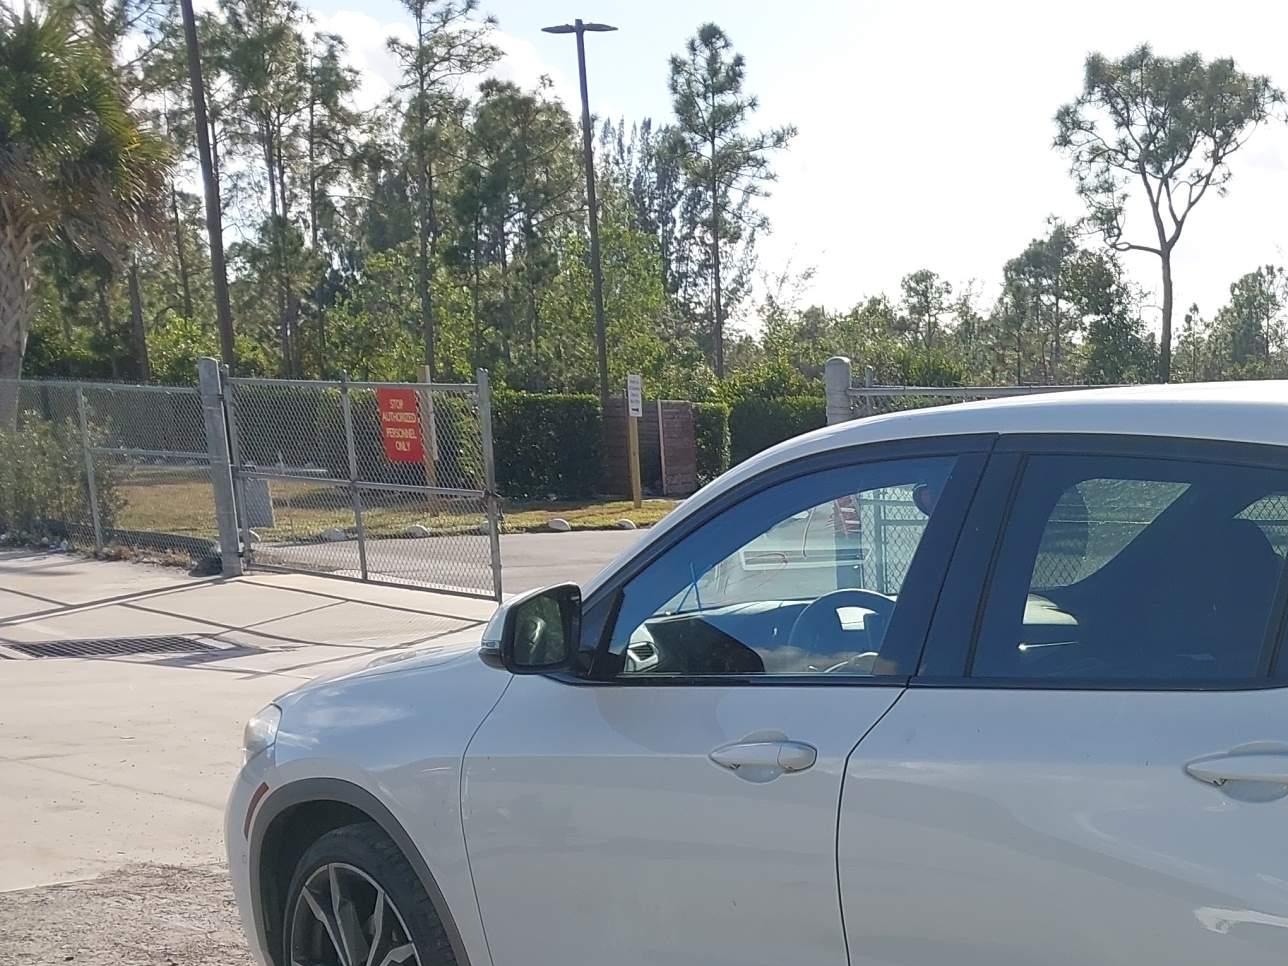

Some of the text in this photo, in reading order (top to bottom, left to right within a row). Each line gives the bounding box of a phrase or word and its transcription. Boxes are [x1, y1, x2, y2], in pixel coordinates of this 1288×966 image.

[382, 411, 416, 423] AUTHORIZED
[386, 427, 417, 439] PERSONNEL
[395, 440, 410, 451] ONLY
